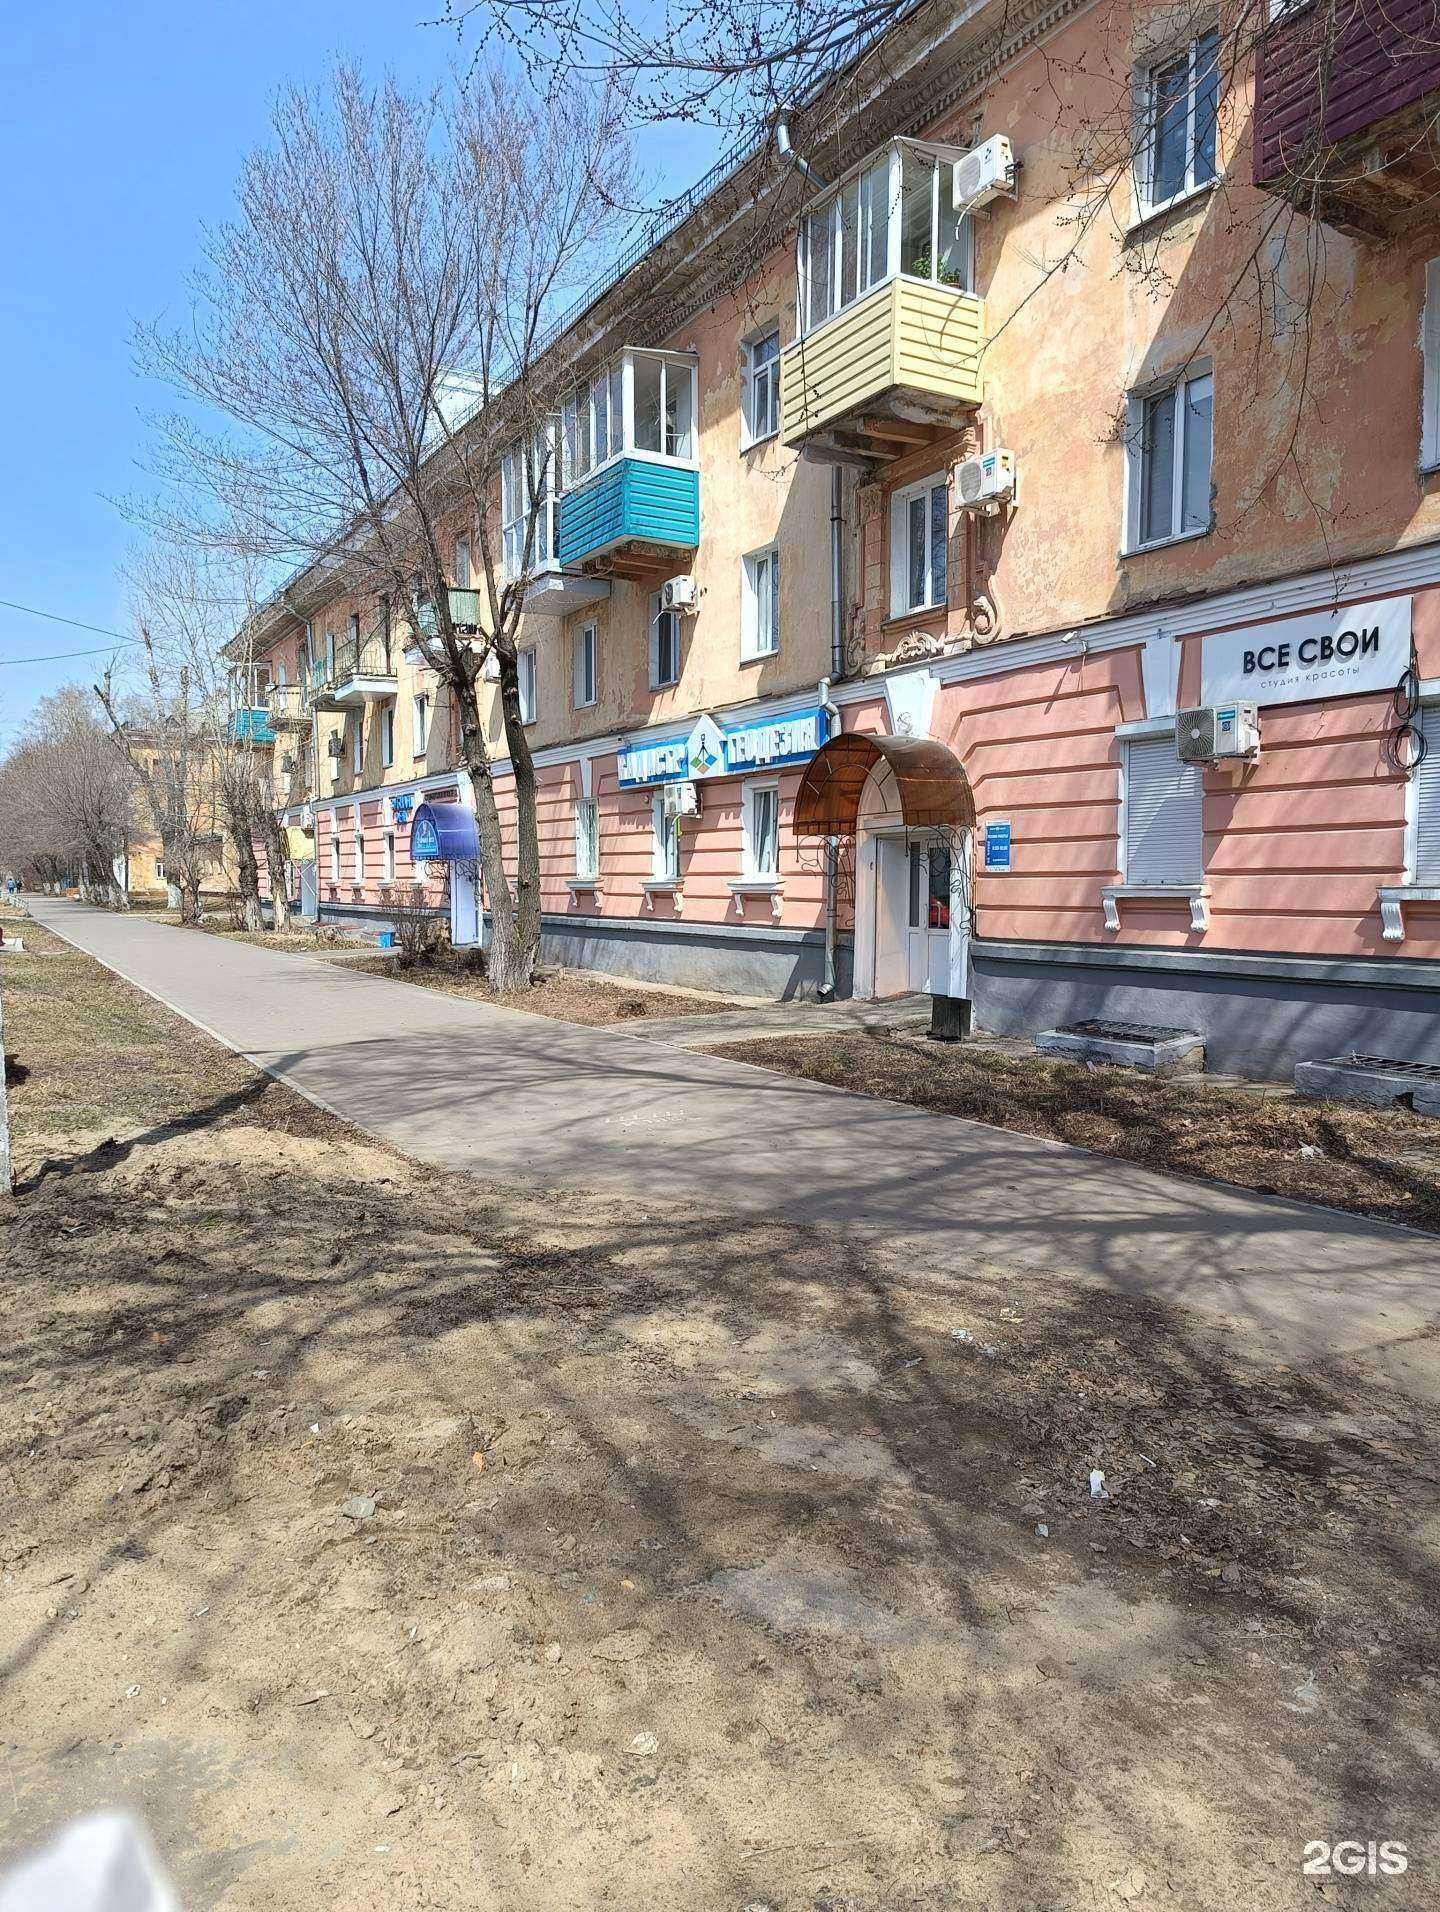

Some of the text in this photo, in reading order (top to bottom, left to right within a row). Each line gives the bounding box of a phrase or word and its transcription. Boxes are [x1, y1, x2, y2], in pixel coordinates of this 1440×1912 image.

[1243, 626, 1379, 674] ВСЕ СВОИ
[1260, 666, 1360, 689] студия красоты
[727, 716, 820, 764] ГЕОДЕЗИЯ
